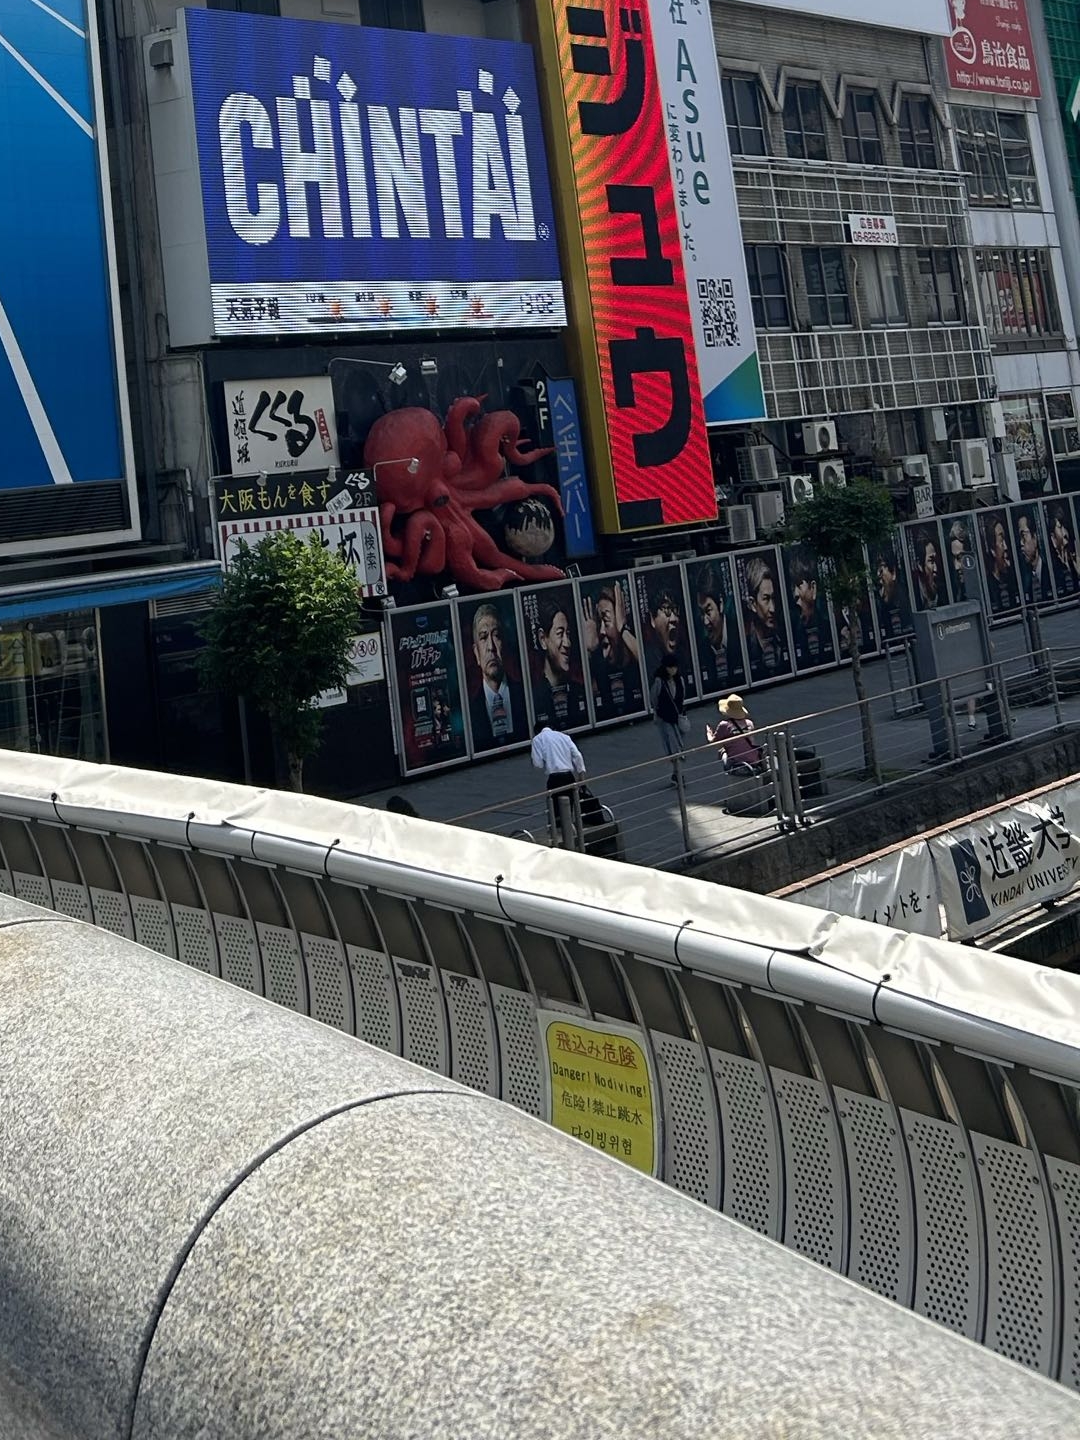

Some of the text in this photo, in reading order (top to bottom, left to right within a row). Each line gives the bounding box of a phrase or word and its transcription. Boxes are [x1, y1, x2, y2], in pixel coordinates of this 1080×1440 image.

[218, 55, 537, 246] CHINTAI
[676, 38, 711, 206] Asue
[666, 103, 697, 262] に変わりました。
[231, 390, 252, 465] 道頓堀
[248, 389, 317, 458] くくる
[535, 380, 549, 430] 2F
[552, 391, 588, 539] ペンギンバー
[219, 480, 332, 515] 大阪もんを食す
[354, 491, 374, 508] 2F
[915, 487, 932, 504] BAR
[363, 532, 378, 571] 検索
[979, 805, 1071, 882] 近畿大学
[552, 1060, 591, 1084] Danger!
[555, 1029, 638, 1068] 飛込み危険
